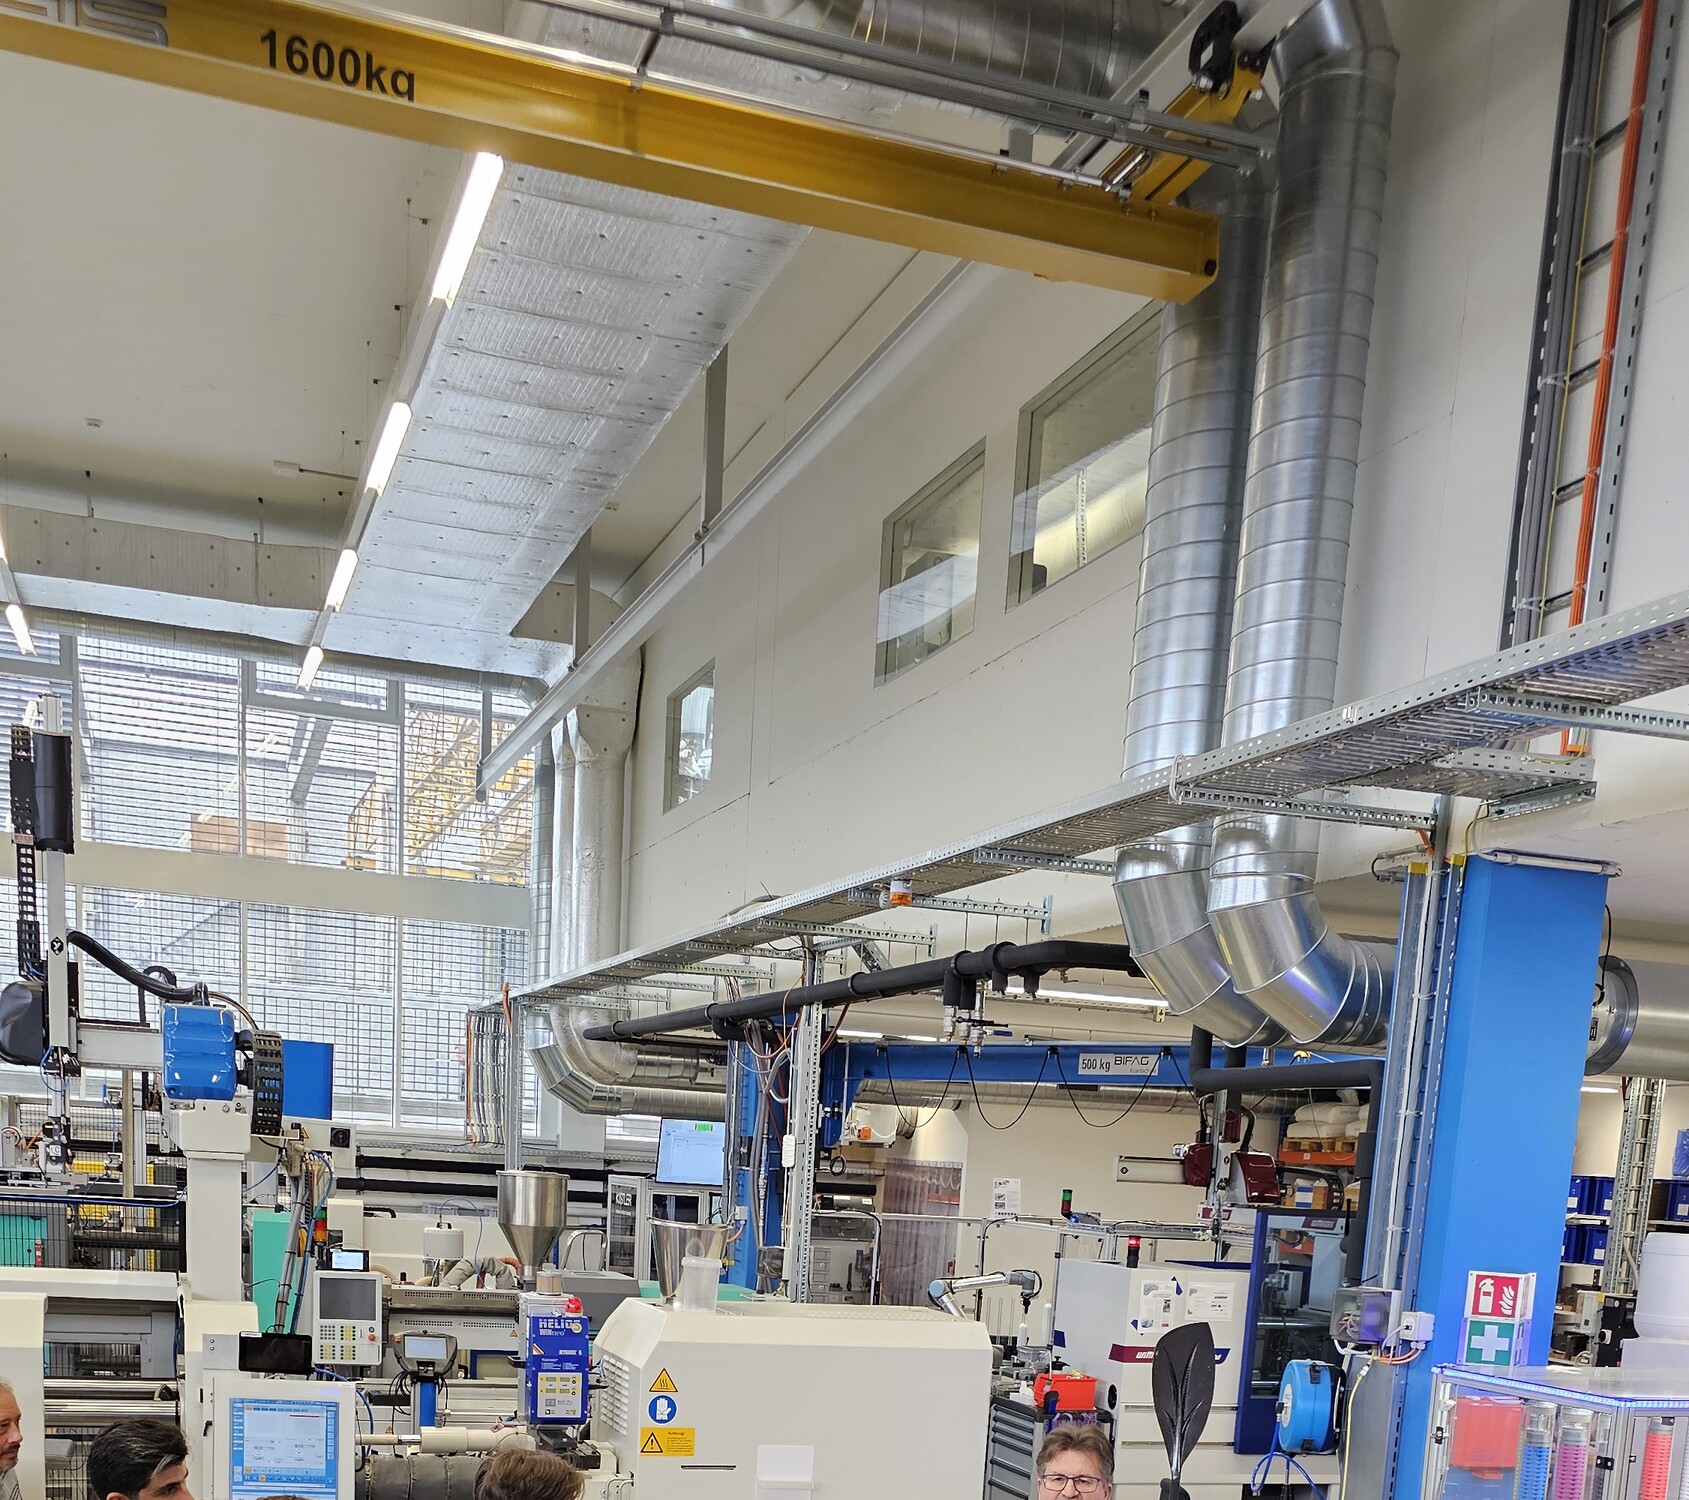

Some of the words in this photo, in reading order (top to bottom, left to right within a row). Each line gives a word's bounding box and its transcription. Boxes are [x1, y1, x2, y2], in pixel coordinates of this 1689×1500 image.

[1081, 1058, 1097, 1070] 500
[1099, 1060, 1111, 1072] kg
[1114, 1056, 1149, 1066] BIFAG
